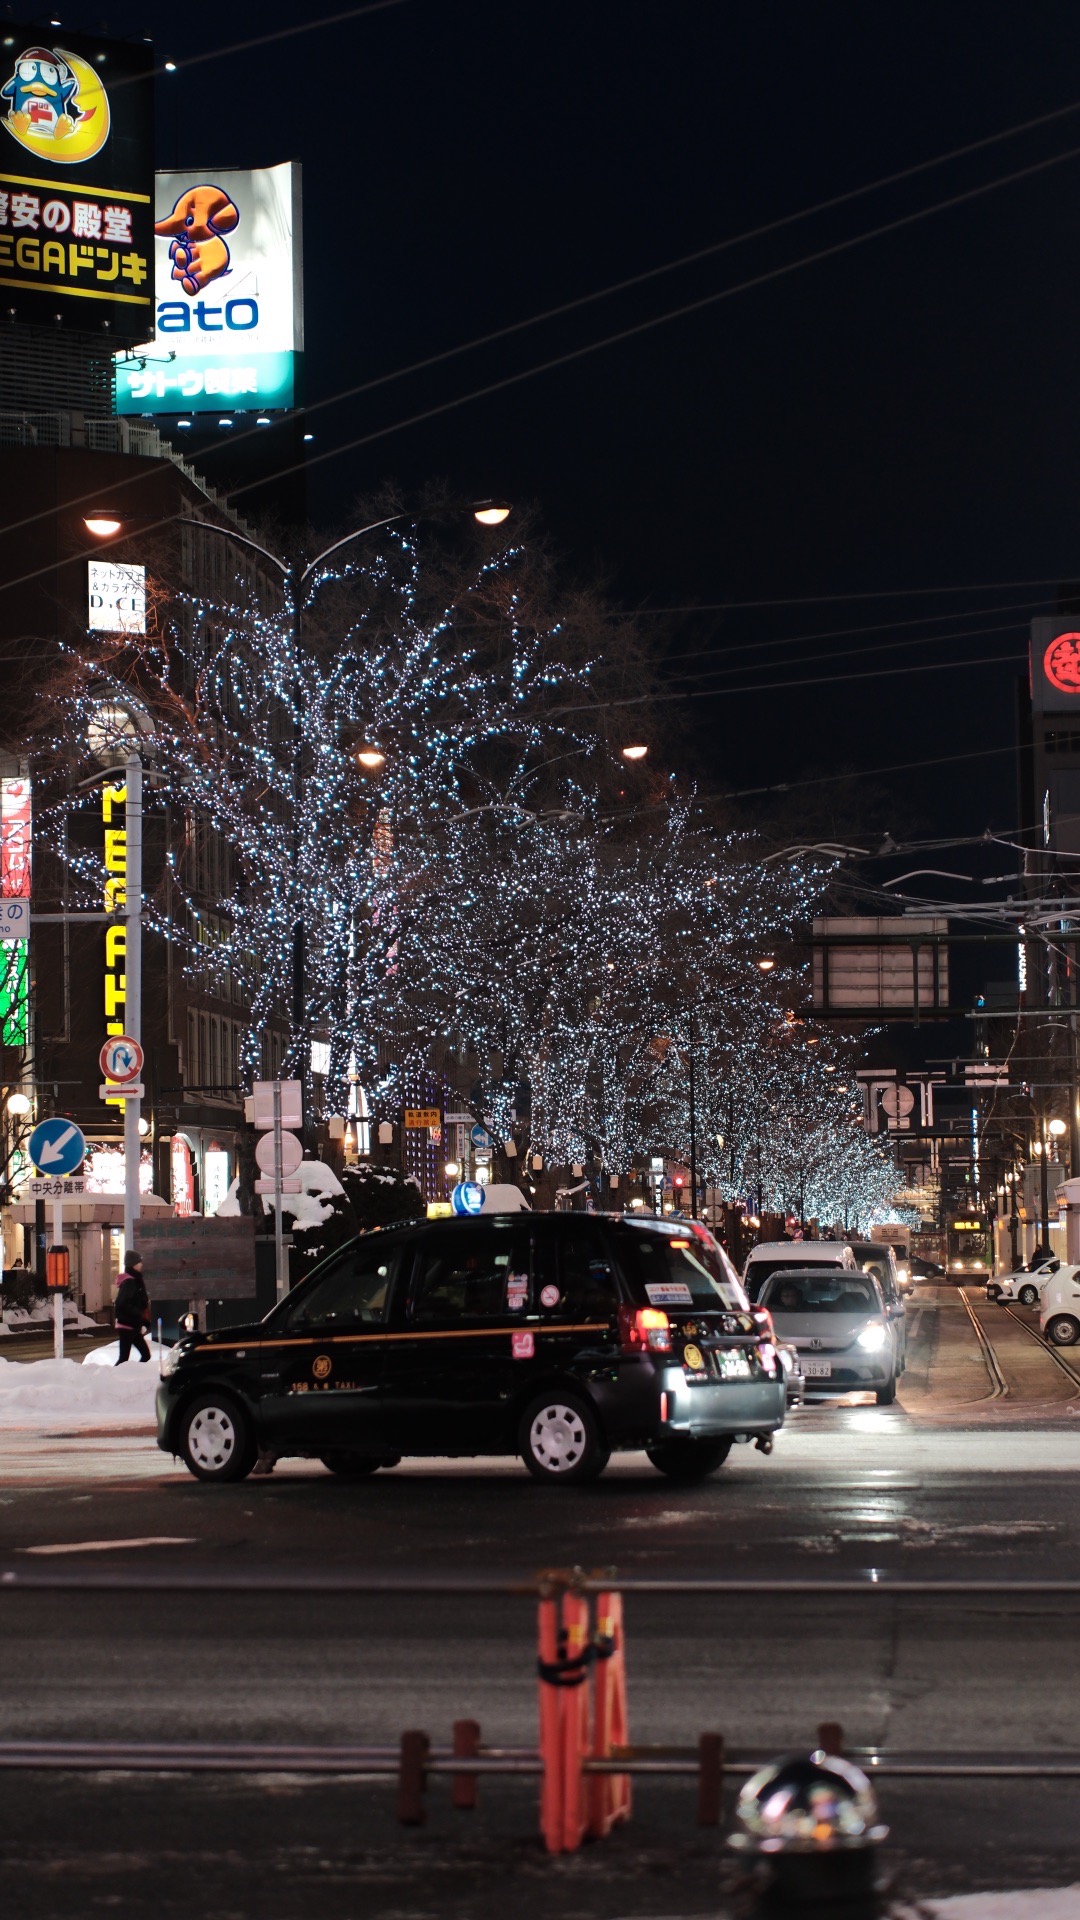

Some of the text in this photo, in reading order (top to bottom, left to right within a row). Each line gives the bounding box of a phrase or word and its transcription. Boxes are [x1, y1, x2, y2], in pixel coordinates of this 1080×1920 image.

[91, 567, 143, 582] ネットカフェ
[0, 904, 23, 919] の
[32, 1181, 84, 1196] 中央分離帯
